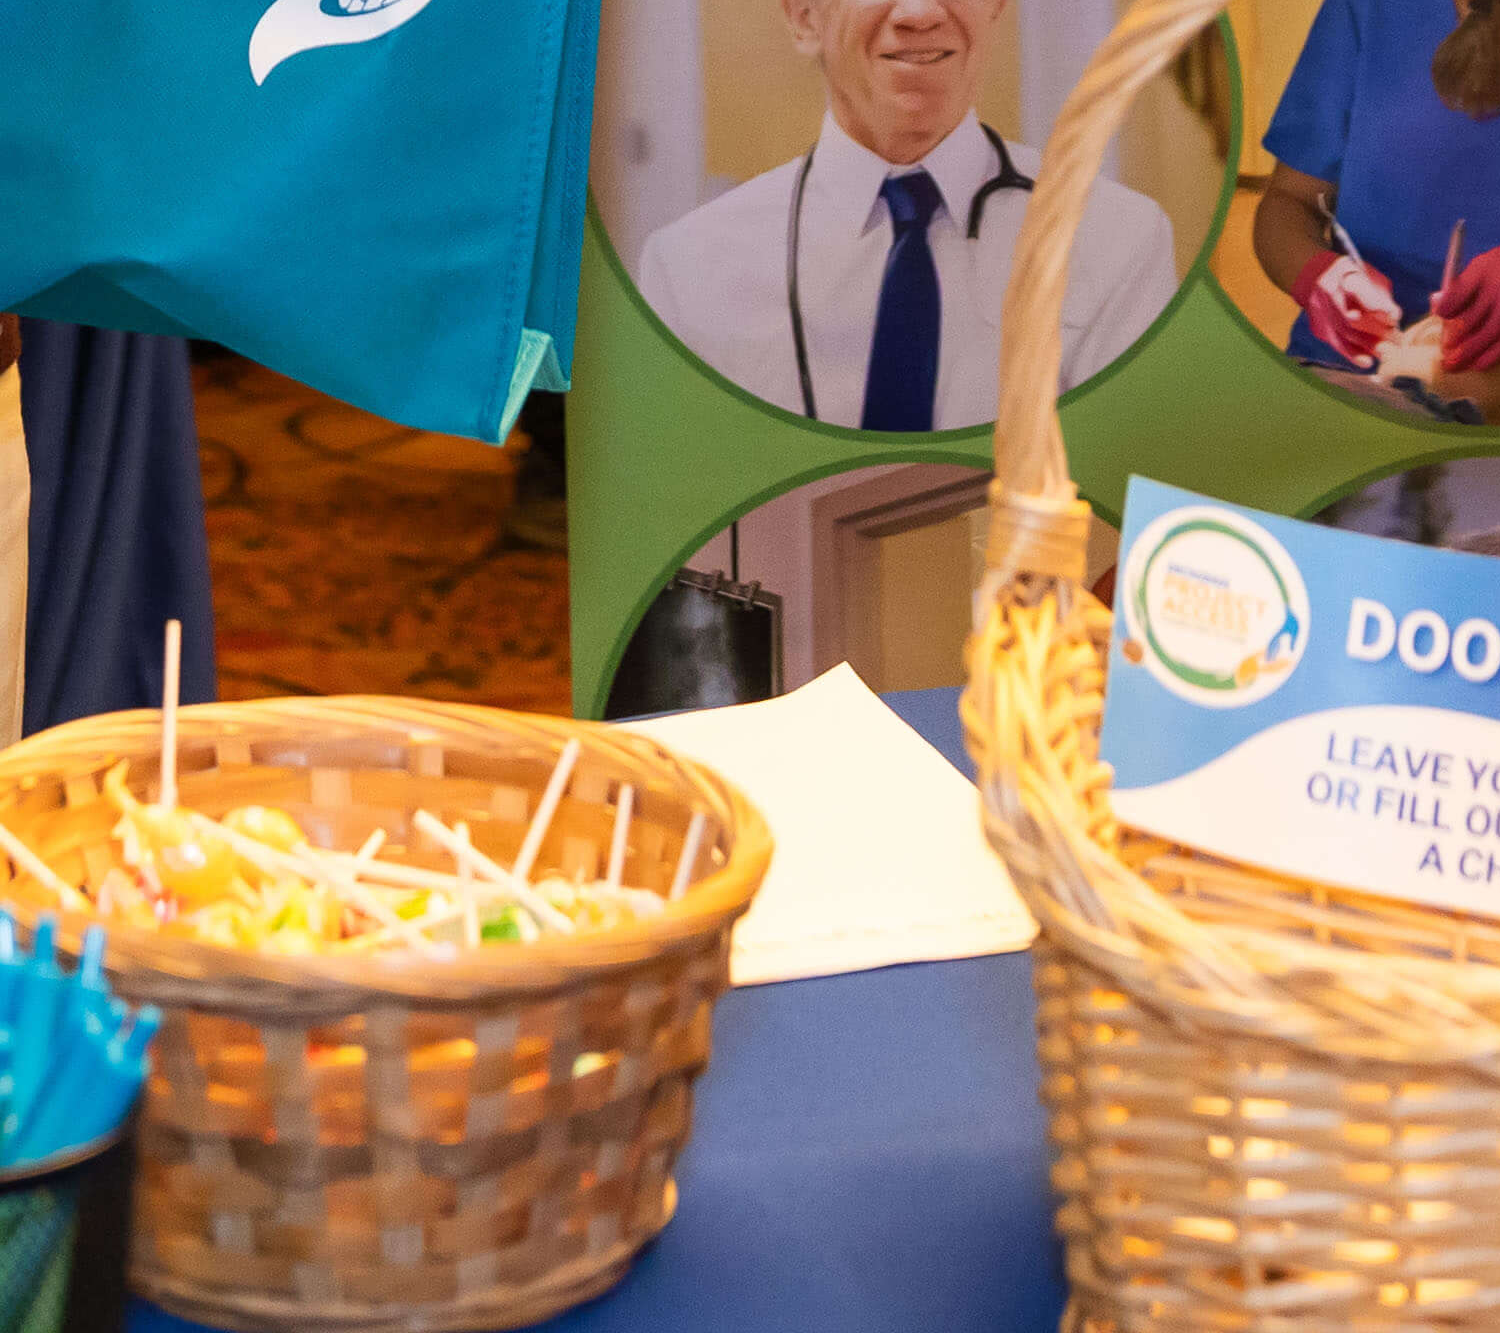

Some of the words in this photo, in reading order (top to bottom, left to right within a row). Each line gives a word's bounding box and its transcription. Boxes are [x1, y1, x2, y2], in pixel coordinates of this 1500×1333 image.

[1326, 732, 1454, 788] LEAVE
[1306, 771, 1360, 811] OR
[1373, 786, 1450, 831] FILL
[1418, 842, 1445, 874] A
